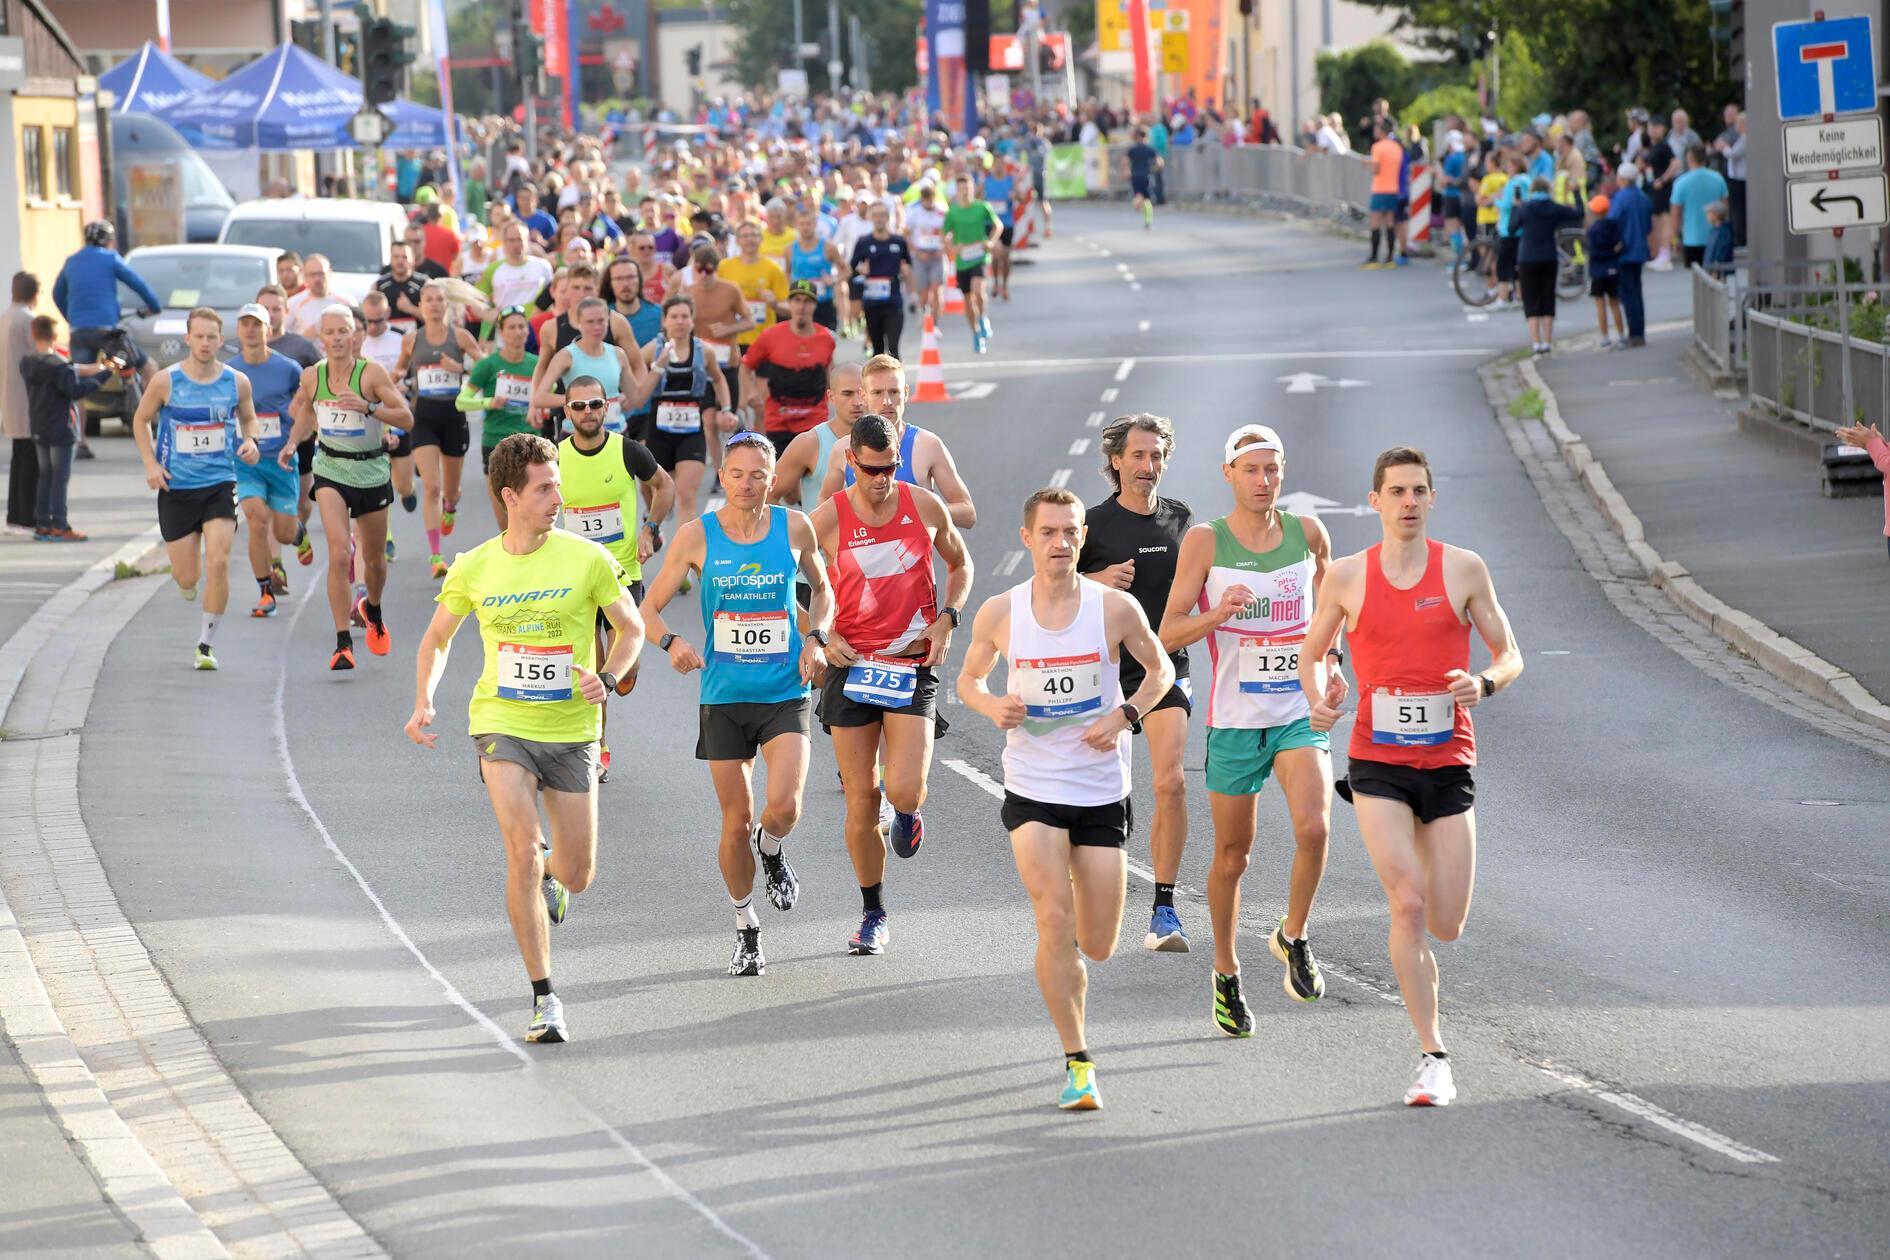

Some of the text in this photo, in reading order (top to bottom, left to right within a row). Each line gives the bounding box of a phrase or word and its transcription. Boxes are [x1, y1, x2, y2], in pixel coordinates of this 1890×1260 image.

[1819, 130, 1845, 142] Keine
[1790, 146, 1877, 165] Wendemöglichkeit
[427, 373, 449, 384] 182
[506, 384, 528, 396] 194
[331, 412, 347, 424] 77
[667, 411, 689, 421] 121
[192, 436, 210, 447] 14
[581, 518, 603, 532] 13
[853, 527, 867, 539] LG
[848, 537, 876, 548] Erlangen
[1138, 545, 1168, 554] saucony
[712, 572, 784, 590] neprosport
[482, 588, 572, 608] DYNAFIT
[743, 592, 776, 600] ATHLETE
[496, 621, 561, 635] TRANS ALPINE RUN
[731, 629, 771, 645] 106
[1258, 653, 1299, 671] 128
[514, 662, 556, 681] 156
[861, 668, 901, 688] 375
[1043, 676, 1074, 695] 40
[1398, 705, 1429, 723] 51
